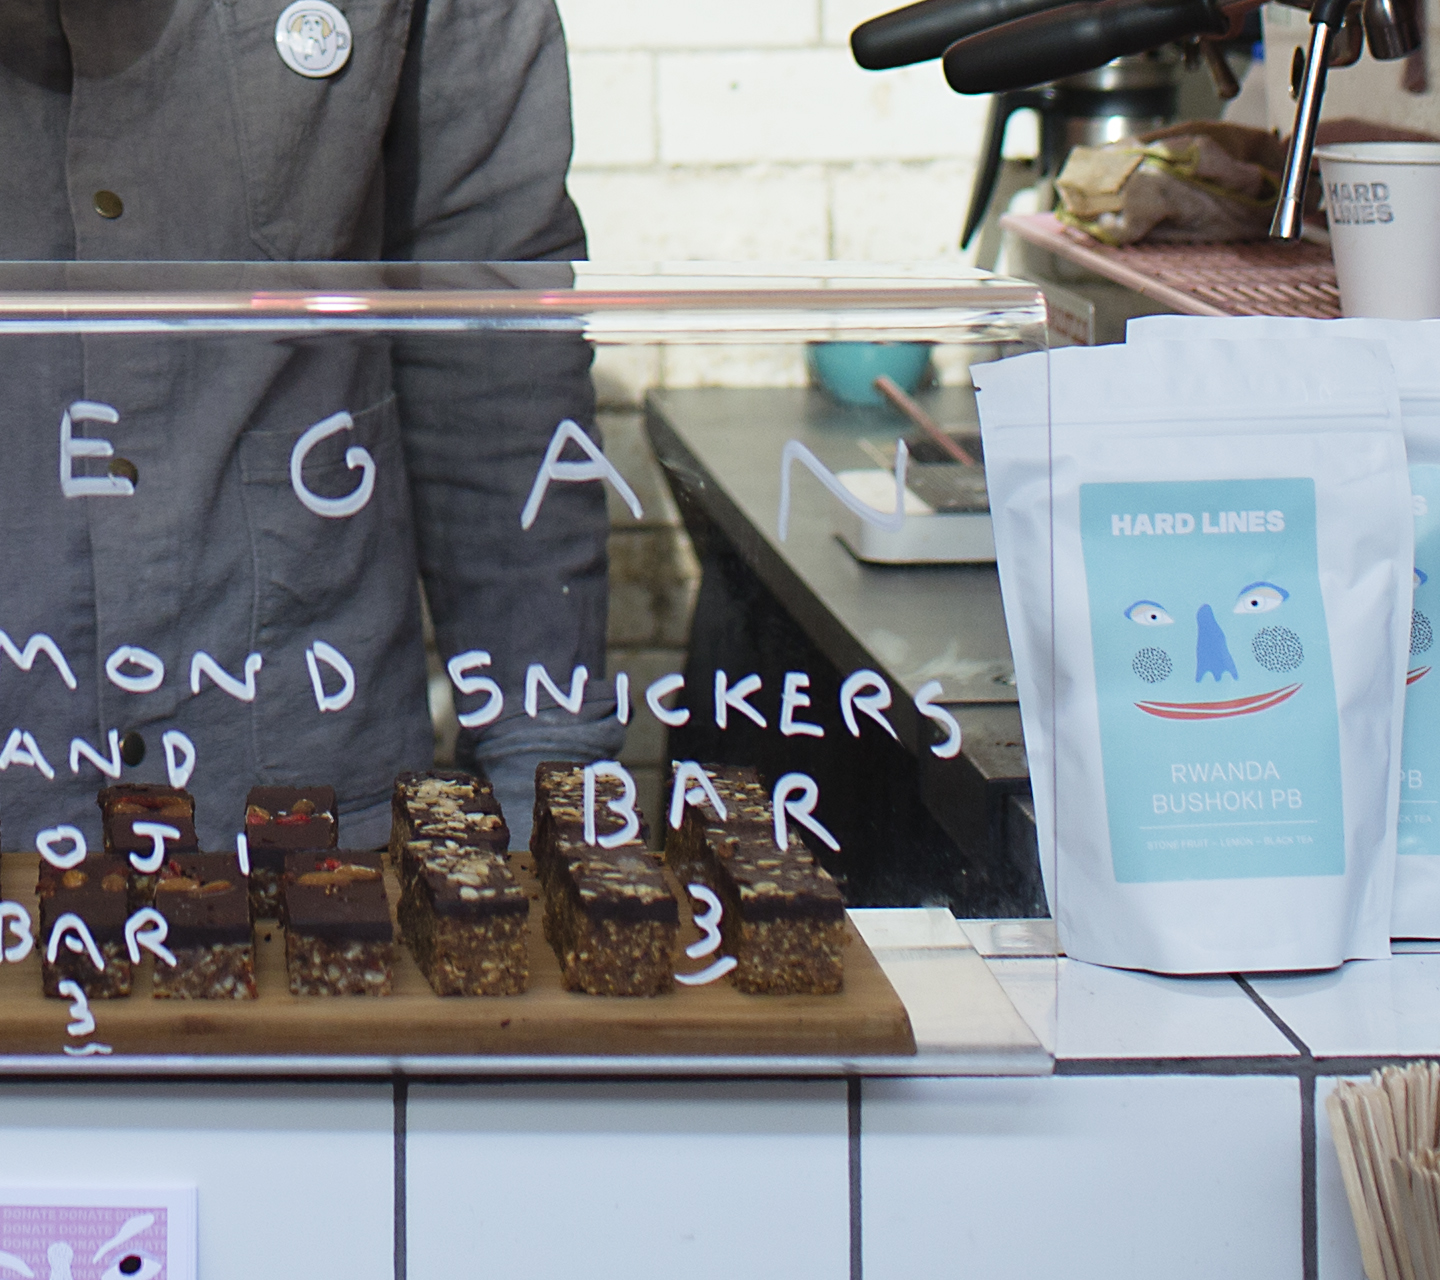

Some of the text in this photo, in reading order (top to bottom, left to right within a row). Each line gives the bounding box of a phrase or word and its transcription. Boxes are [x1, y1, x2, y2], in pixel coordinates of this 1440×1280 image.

[1327, 182, 1390, 202] HARD
[1331, 203, 1394, 225] LINES
[1111, 510, 1286, 537] HARD LINES
[448, 647, 962, 760] SNICKERS
[1171, 760, 1280, 783] RWANDA
[583, 760, 840, 852] BAR
[1152, 789, 1302, 814] BUSHOKI PB
[1146, 835, 1313, 851] STONE FRUIT LEMON BLACK TEA
[3, 1208, 55, 1221] DONATE
[59, 1209, 111, 1222] DONATE
